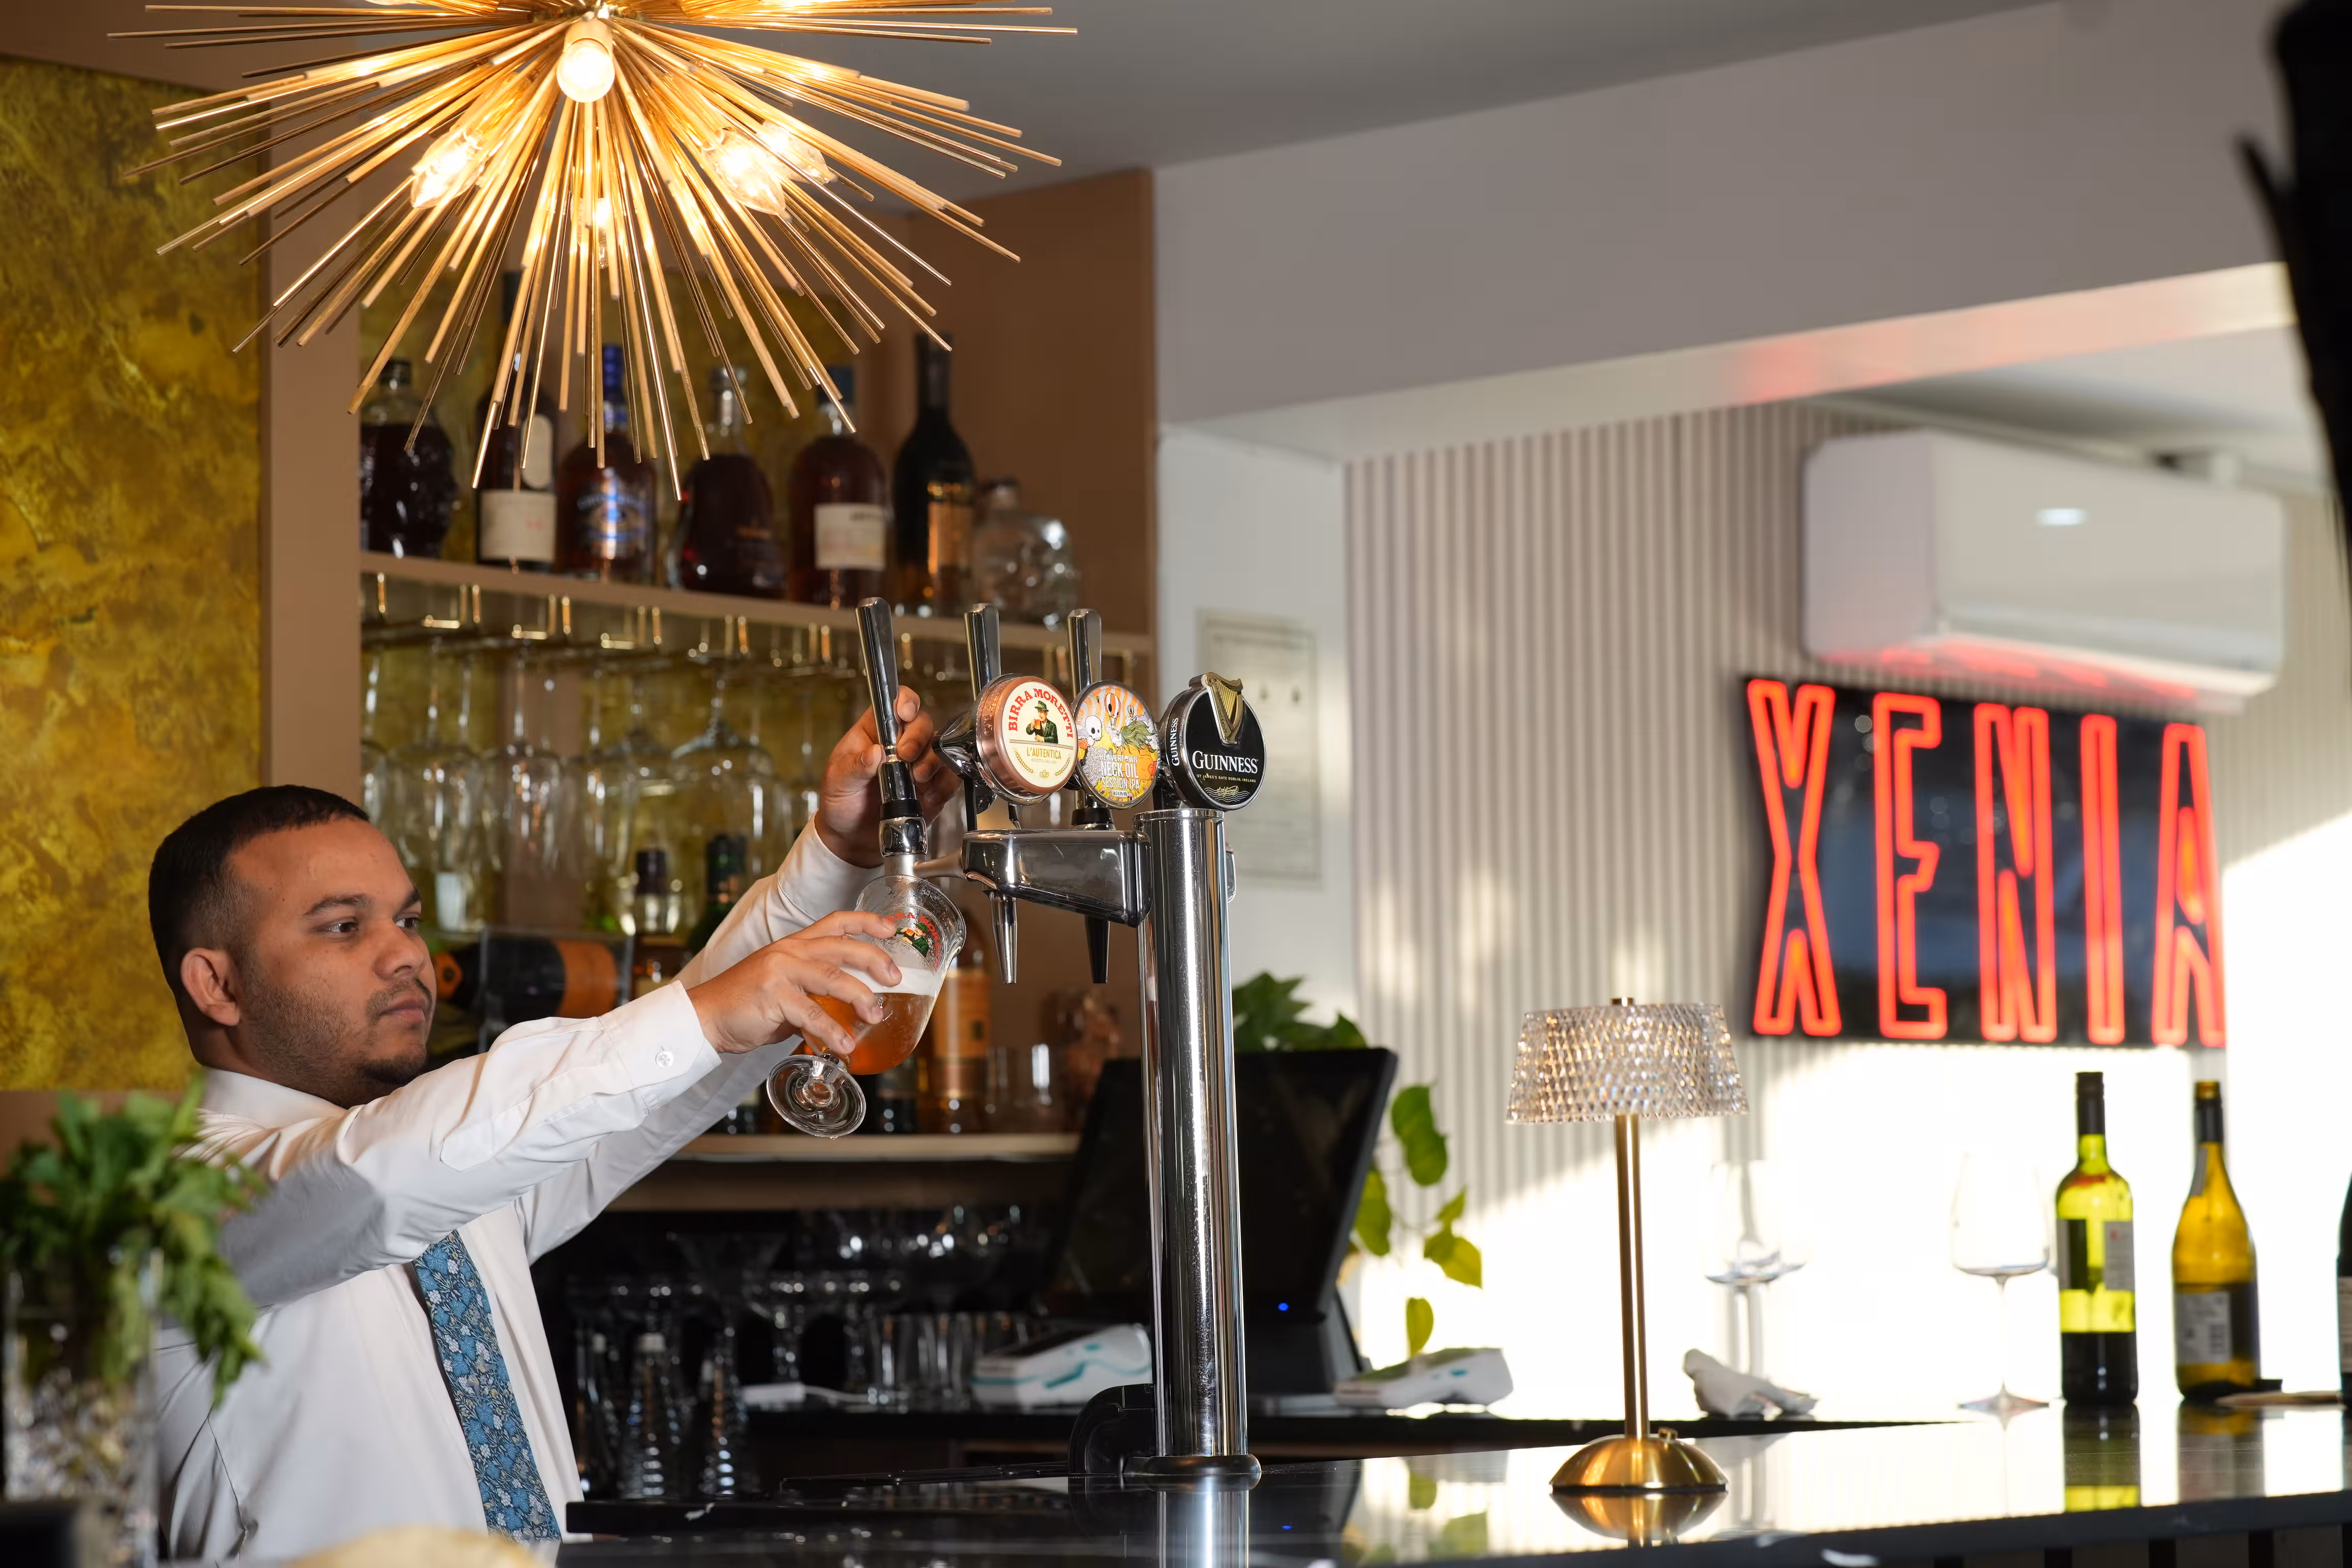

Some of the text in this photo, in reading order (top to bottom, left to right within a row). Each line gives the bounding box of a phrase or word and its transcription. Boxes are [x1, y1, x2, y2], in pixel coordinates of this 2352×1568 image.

[1009, 691, 1033, 731] BIRRA
[1033, 688, 1073, 738] MORETTI
[1027, 747, 1062, 760] L'AUTENTICA
[1170, 718, 1180, 766] GUINNESS
[1101, 761, 1139, 778] NECK OIL
[1192, 750, 1258, 774] GUINNESS
[1102, 776, 1140, 790] SESSION IPA
[1747, 679, 2227, 1048] XENIA
